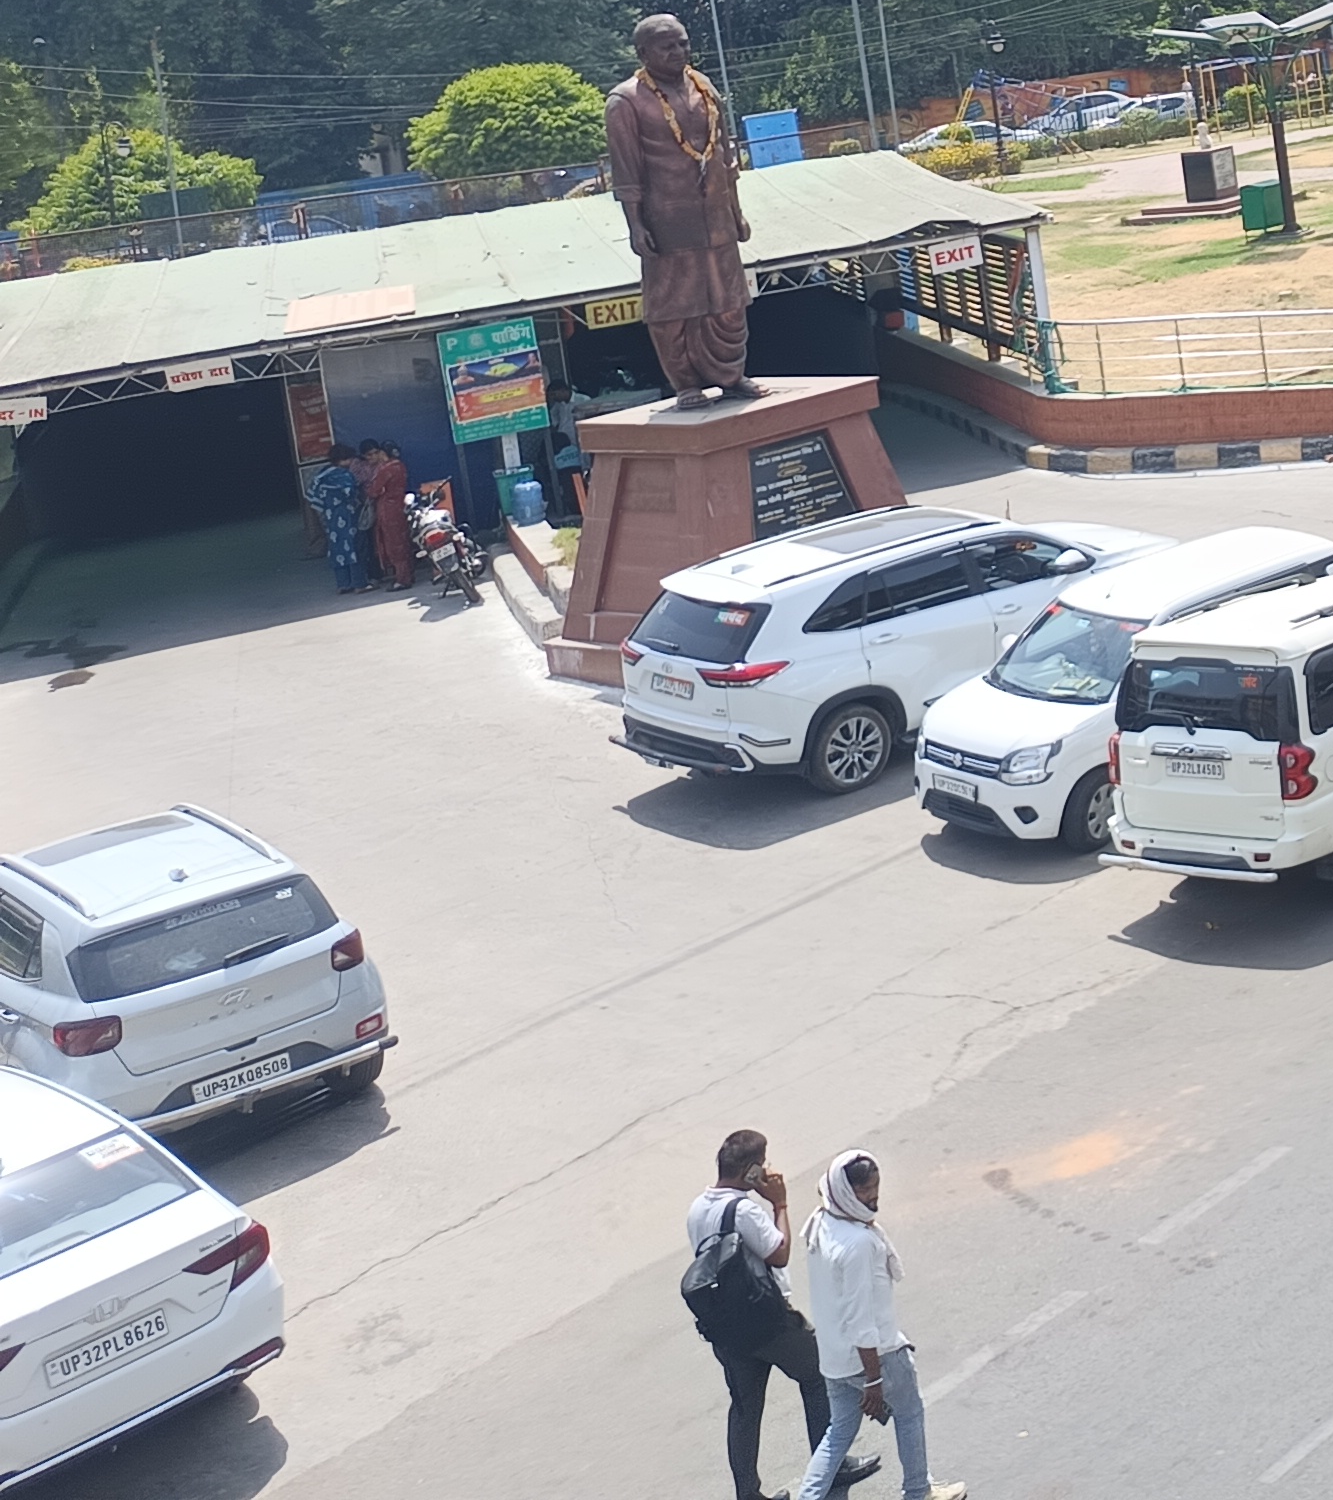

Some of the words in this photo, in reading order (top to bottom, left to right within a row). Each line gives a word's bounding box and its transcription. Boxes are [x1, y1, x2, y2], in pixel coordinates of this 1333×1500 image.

[935, 244, 977, 266] EXIT
[593, 302, 641, 326] EXIT
[491, 323, 531, 344] पार्किंग
[446, 338, 458, 351] P
[29, 408, 44, 419] IN
[1171, 761, 1222, 776] UP32LX4503
[60, 1314, 165, 1377] UP32PL8626
